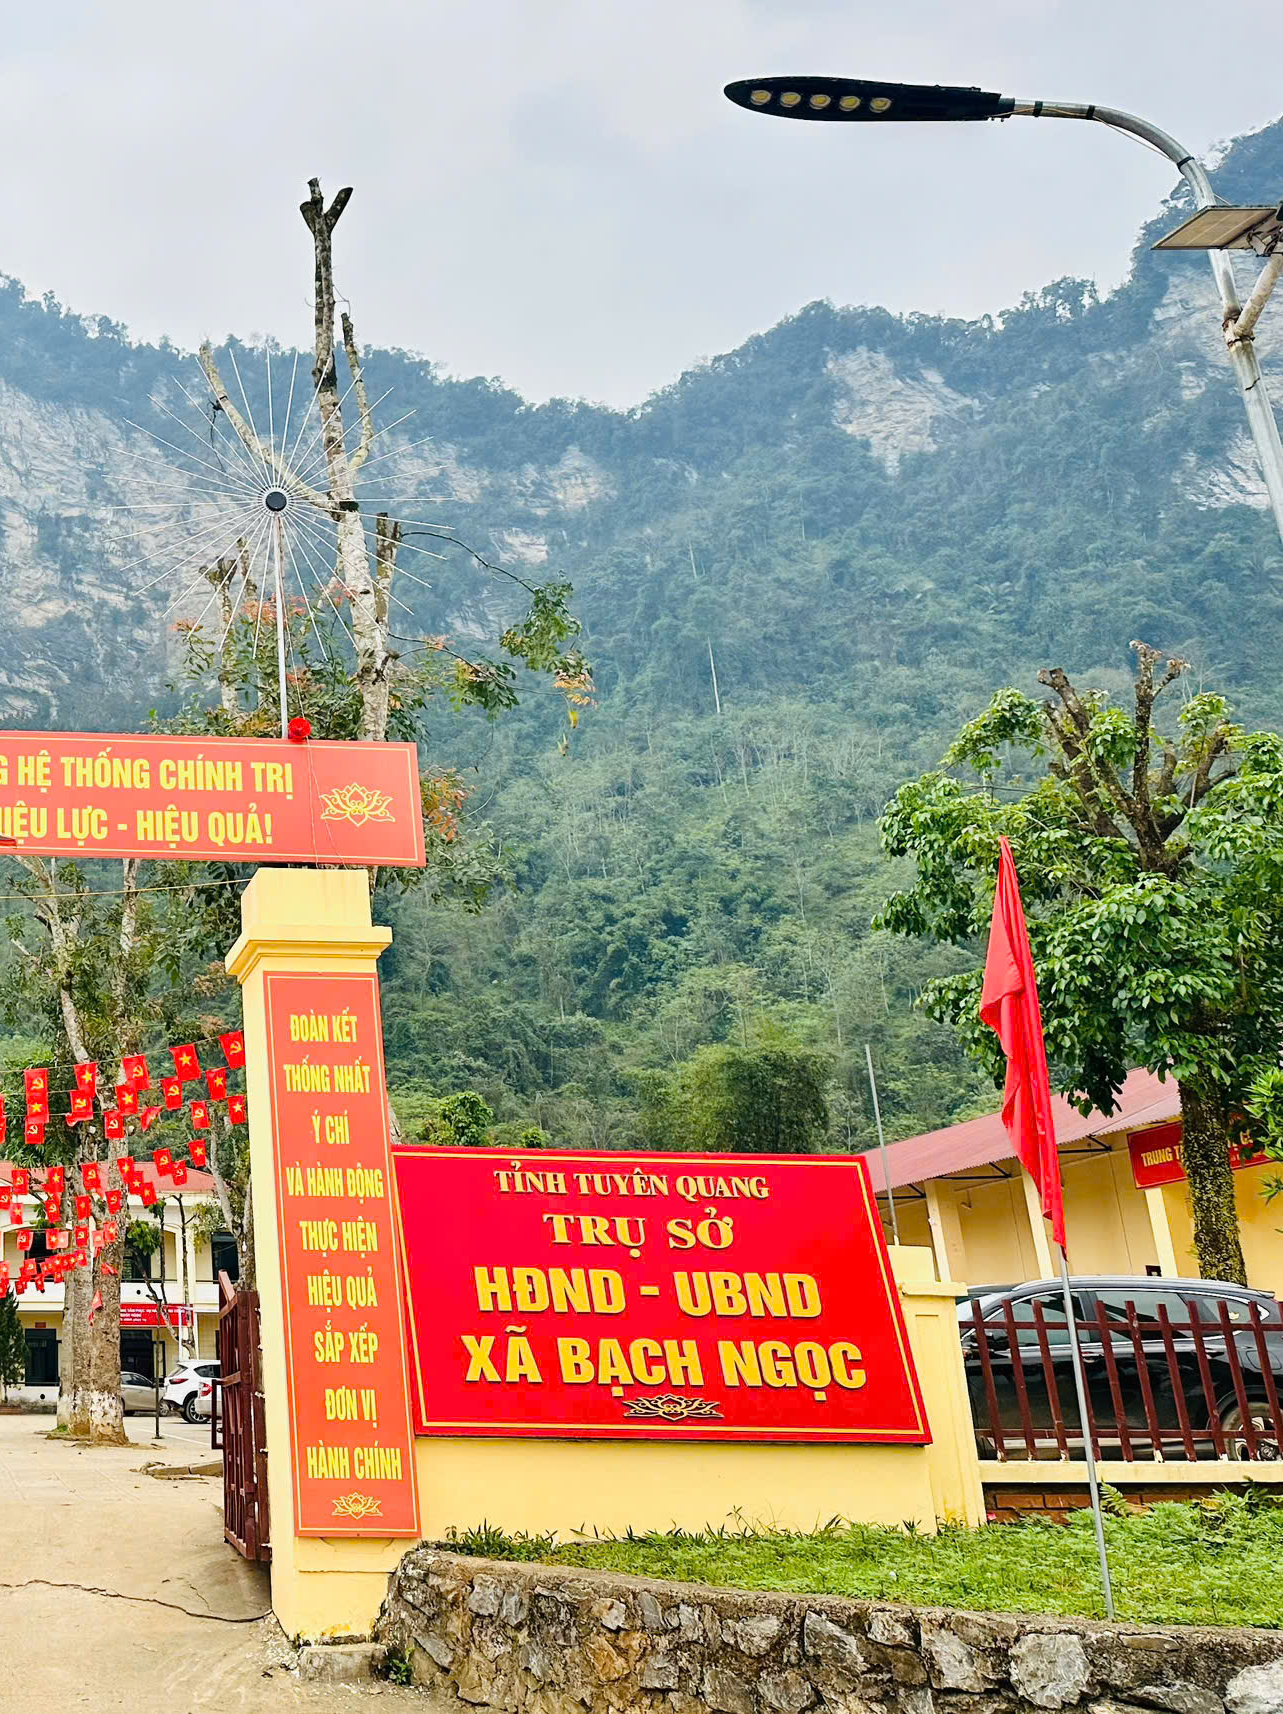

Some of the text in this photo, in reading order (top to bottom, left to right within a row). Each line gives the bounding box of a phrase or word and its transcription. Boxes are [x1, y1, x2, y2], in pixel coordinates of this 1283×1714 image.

[17, 750, 54, 793] HỆ
[61, 745, 150, 788] THỐNG
[159, 753, 243, 792] CHÍNH
[252, 761, 293, 800] TRỊ
[57, 807, 108, 847] LỰC
[117, 823, 127, 831] -
[135, 804, 200, 849] HIỆU
[208, 804, 273, 846] QUẢ!
[290, 1006, 357, 1042] ĐOÀN KẾT
[283, 1054, 370, 1093] THỐNG NHẤT
[312, 1109, 350, 1144] Ý CHÍ
[1141, 1147, 1173, 1167] TRUNG
[286, 1161, 384, 1204] VÀ HÀNH ĐỘNG
[494, 1161, 770, 1201] TỈNH TUYÊN QUANG
[300, 1216, 378, 1258] THỰC HIỆN
[543, 1207, 734, 1259] TRỤ SỞ
[307, 1266, 378, 1313] HIỆU QUẢ
[474, 1266, 822, 1319] HĐND - UBND
[314, 1320, 379, 1364] SẮP XẾP
[460, 1325, 867, 1401] XÃ BẠCH NGỌC
[325, 1385, 378, 1428] ĐƠN VỊ
[307, 1440, 402, 1480] HÀNH CHÍNH
